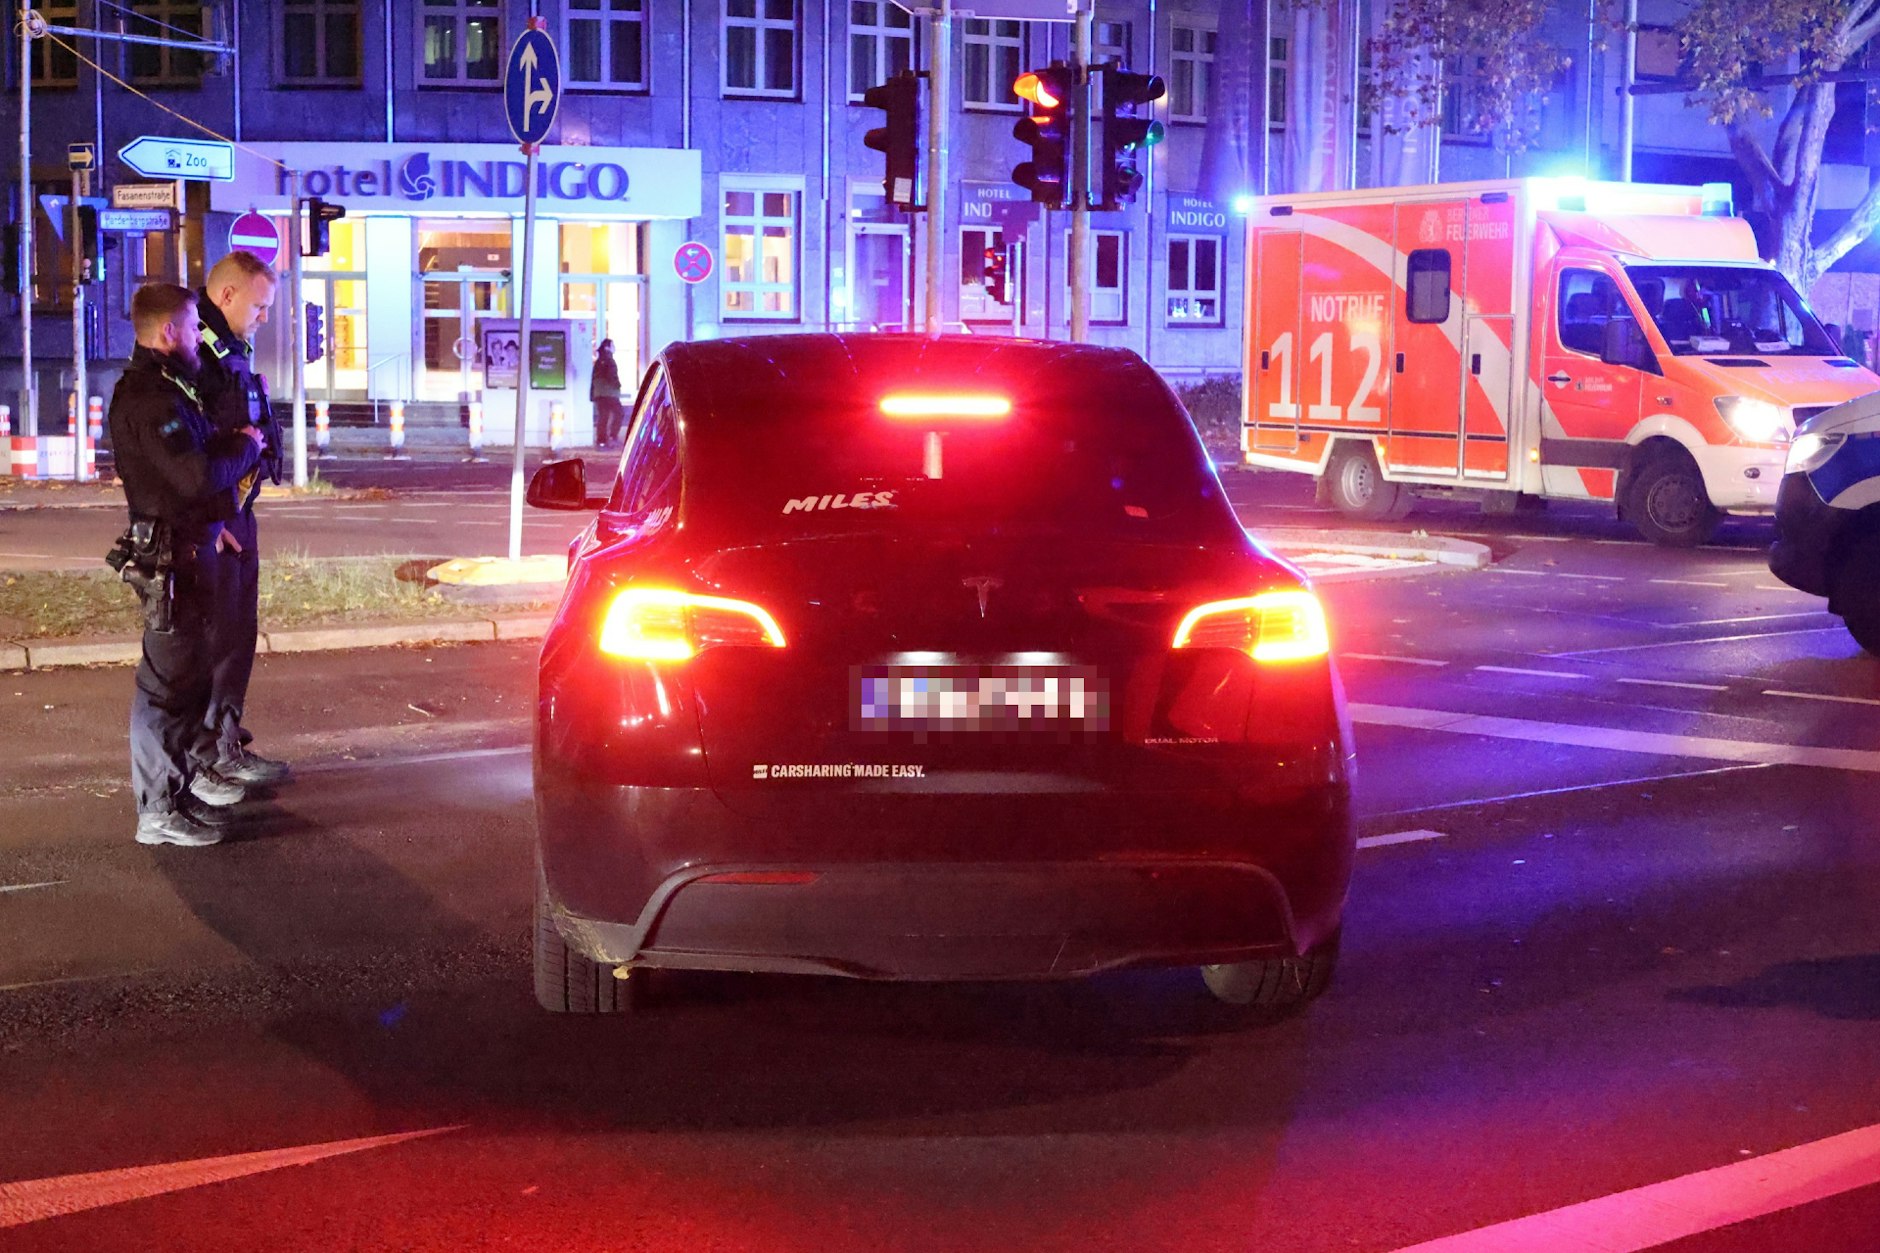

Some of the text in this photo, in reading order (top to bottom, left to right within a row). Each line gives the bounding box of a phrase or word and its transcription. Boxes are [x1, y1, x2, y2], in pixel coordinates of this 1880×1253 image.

[186, 152, 208, 168] Zoo
[274, 158, 630, 201] hotel INDIGO
[117, 190, 171, 202] Fasanenstraße
[977, 188, 1011, 199] HOTEL
[963, 201, 992, 218] IND
[1447, 206, 1489, 221] BERINER
[1171, 210, 1226, 228] INDIGO
[1446, 222, 1508, 241] FEUERWEHR
[1311, 294, 1385, 323] NOTRUF
[1268, 331, 1382, 422] 112
[781, 491, 894, 515] MILES
[771, 764, 851, 778] CARSHARING
[854, 764, 889, 778] MADE
[892, 764, 926, 778] EASY.
